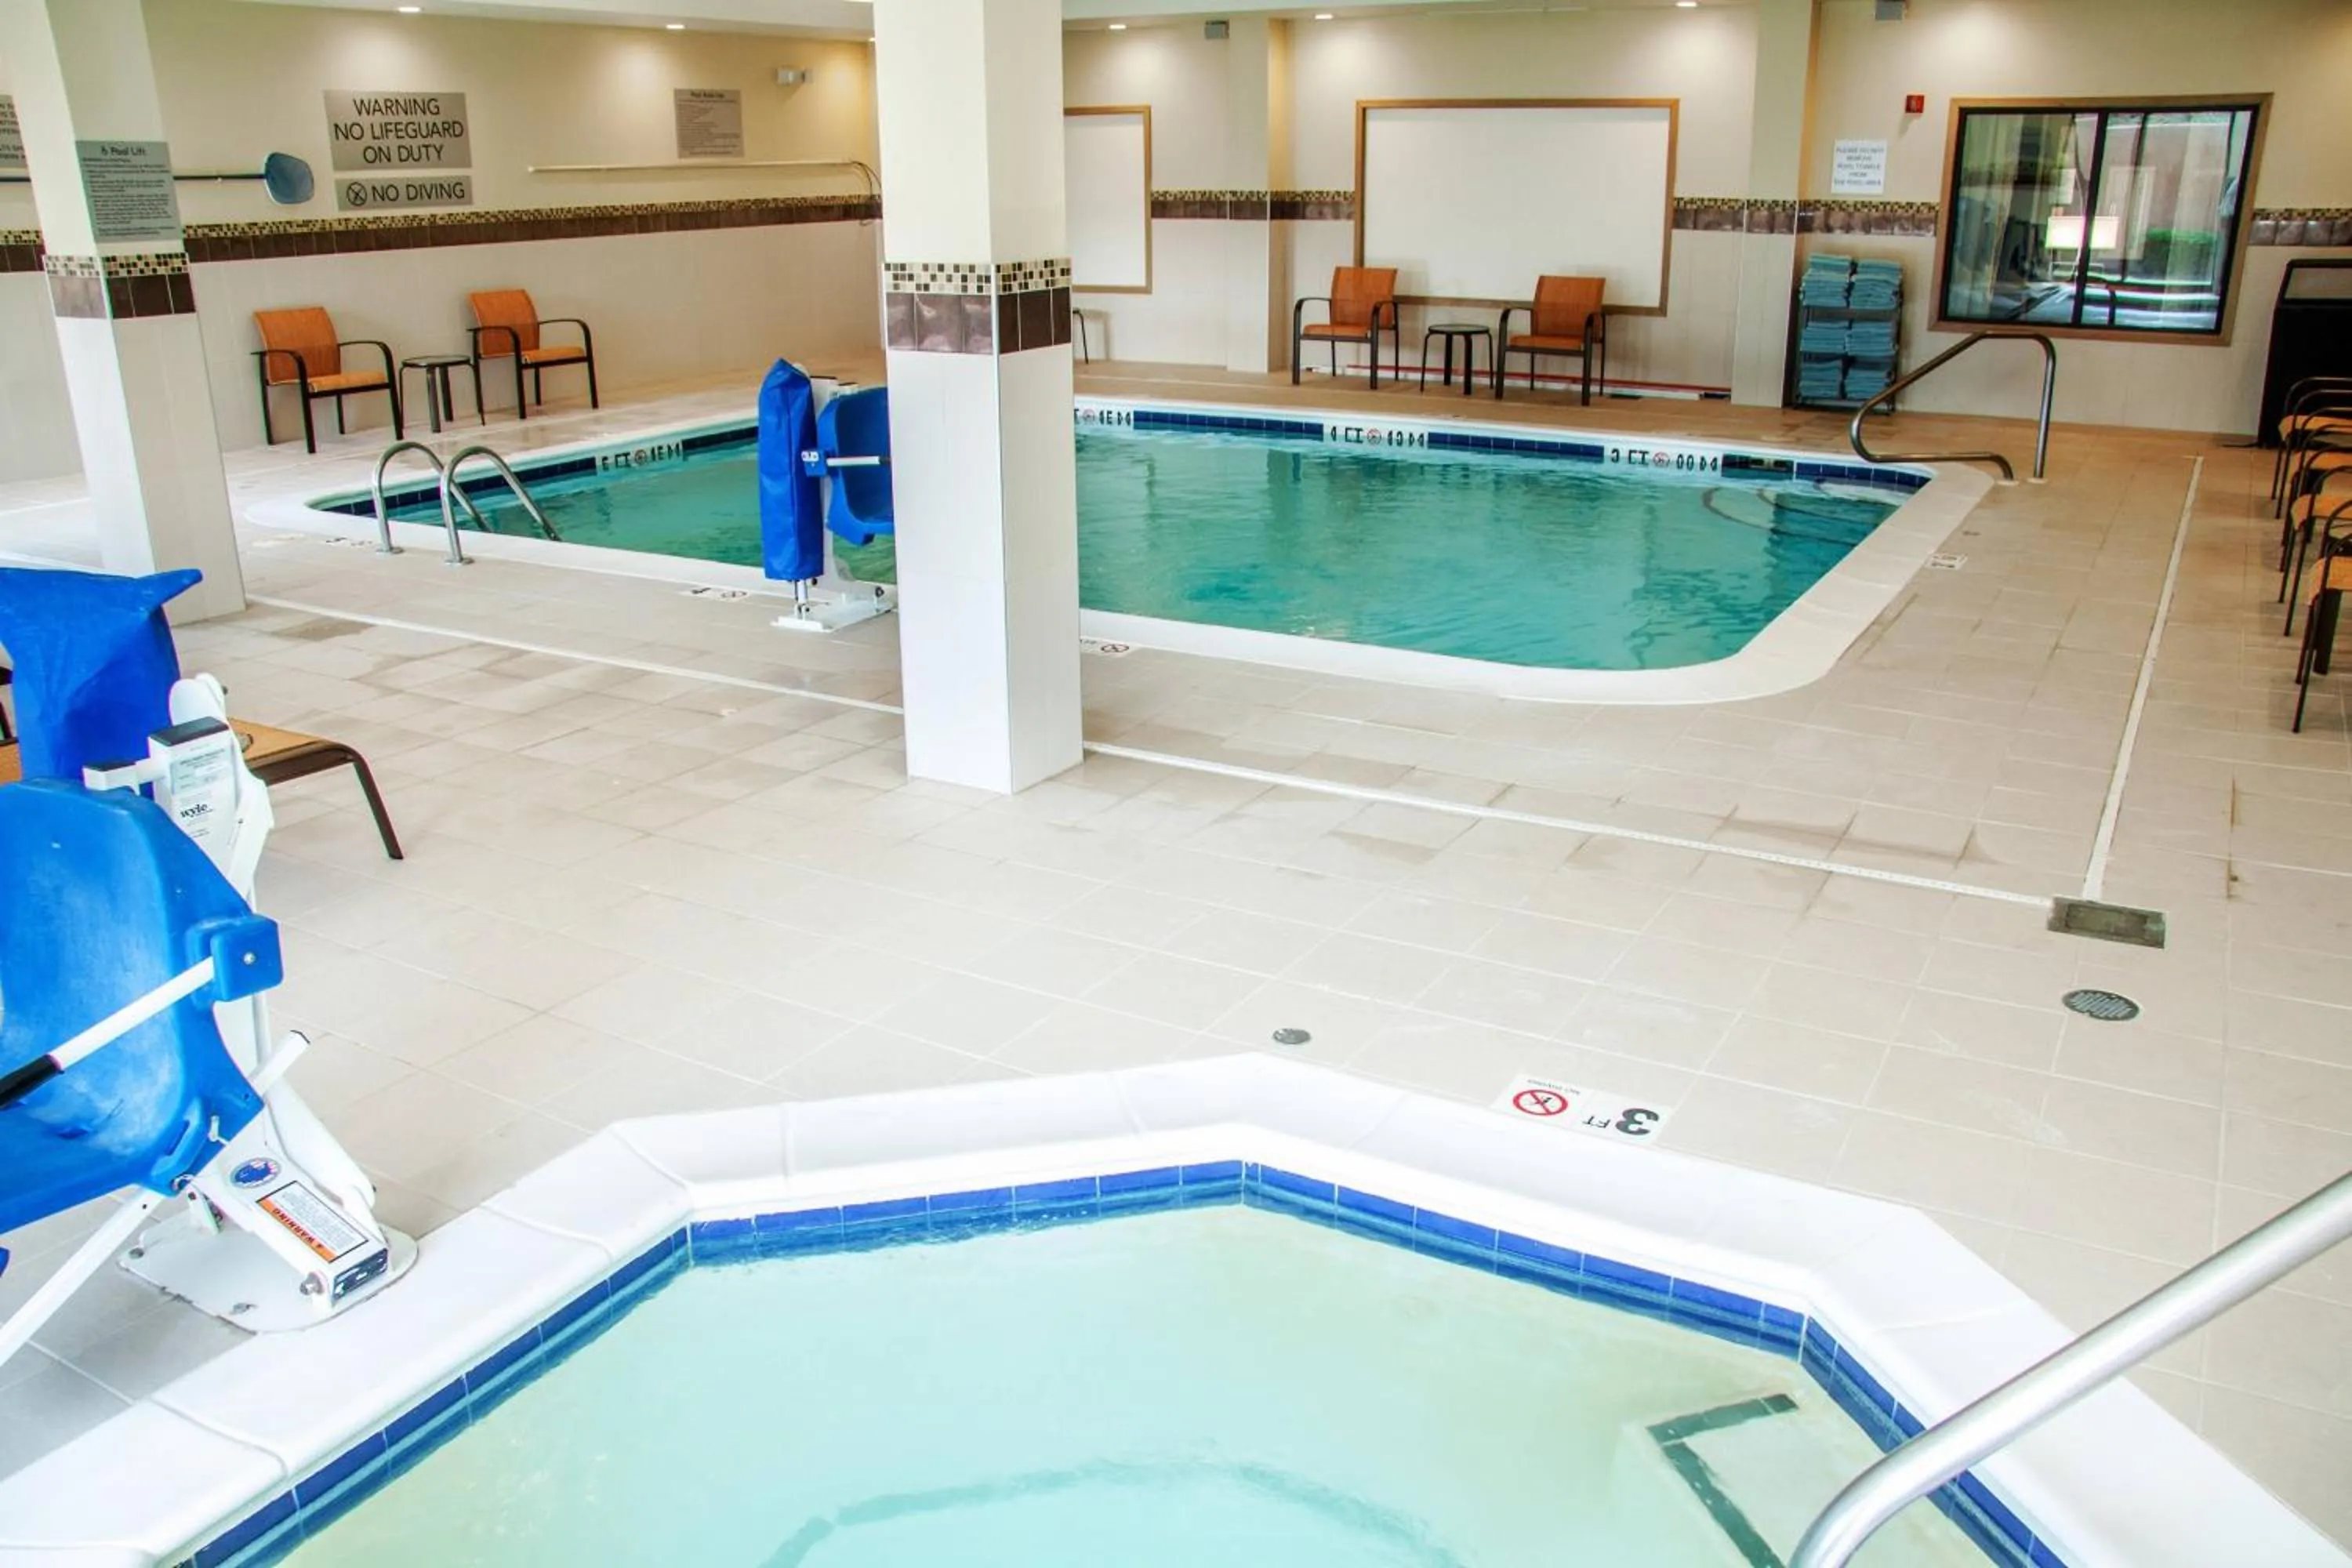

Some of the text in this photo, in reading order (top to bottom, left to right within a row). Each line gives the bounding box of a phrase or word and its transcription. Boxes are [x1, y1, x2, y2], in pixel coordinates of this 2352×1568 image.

[354, 98, 441, 117] WARNING
[333, 120, 464, 141] NO LIFEGUARD
[362, 143, 445, 164] ON DUTY
[371, 182, 465, 202] NO DIVING
[1582, 1108, 1660, 1135] 3 FT
[272, 1208, 316, 1243] WARNING
